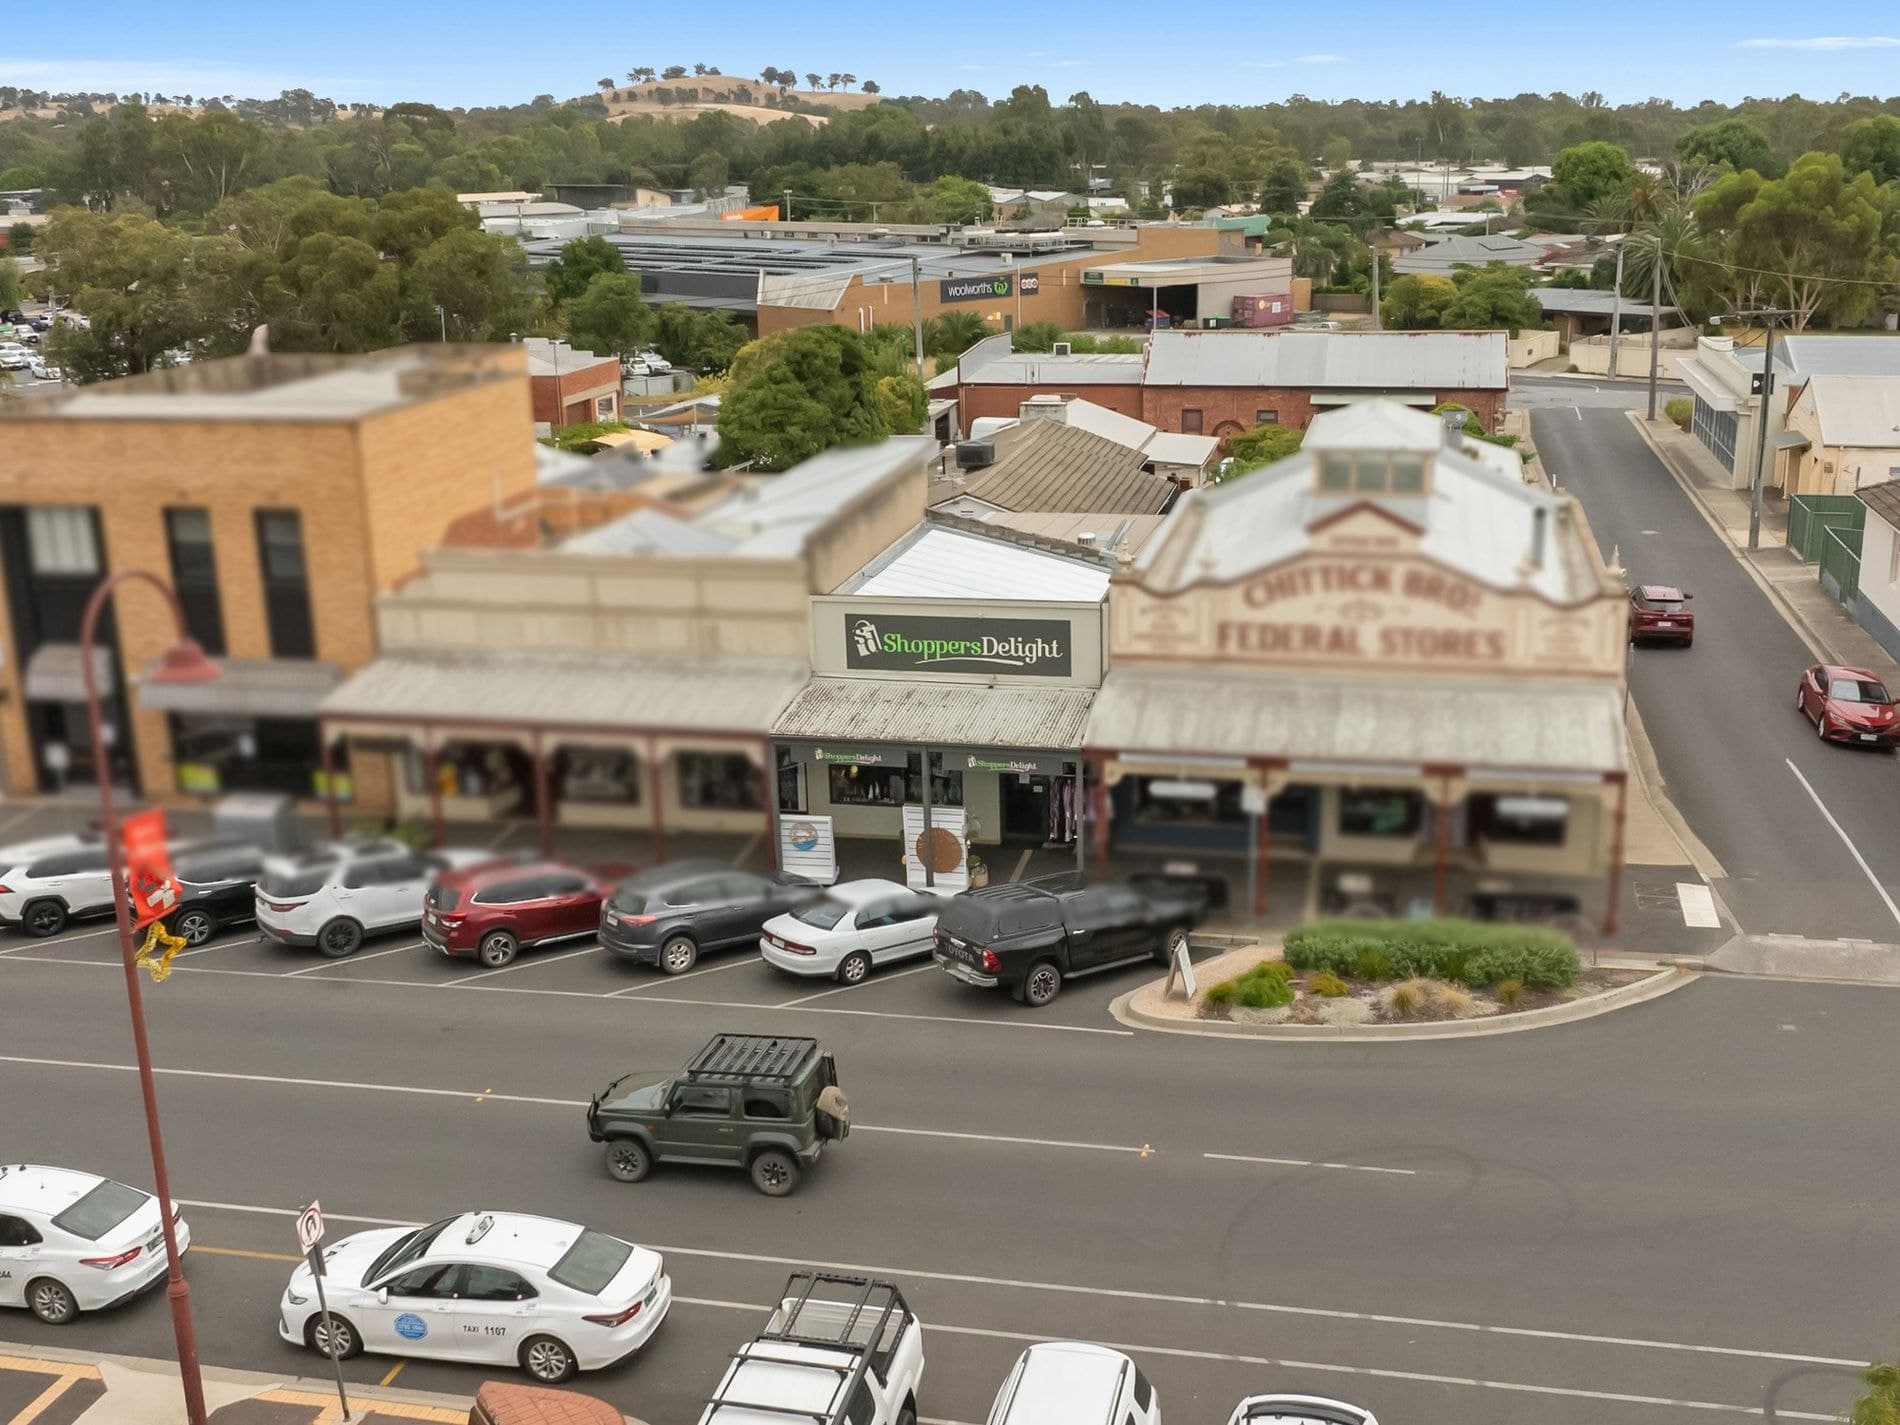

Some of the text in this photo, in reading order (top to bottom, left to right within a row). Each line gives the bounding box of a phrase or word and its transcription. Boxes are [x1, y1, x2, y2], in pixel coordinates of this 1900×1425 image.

[1242, 565, 1392, 610] CHITTICK
[1217, 620, 1369, 657] FEDERAL
[1378, 626, 1506, 659] STORES
[944, 942, 975, 964] TOYOTA
[463, 1325, 506, 1336] TAXI 1107
